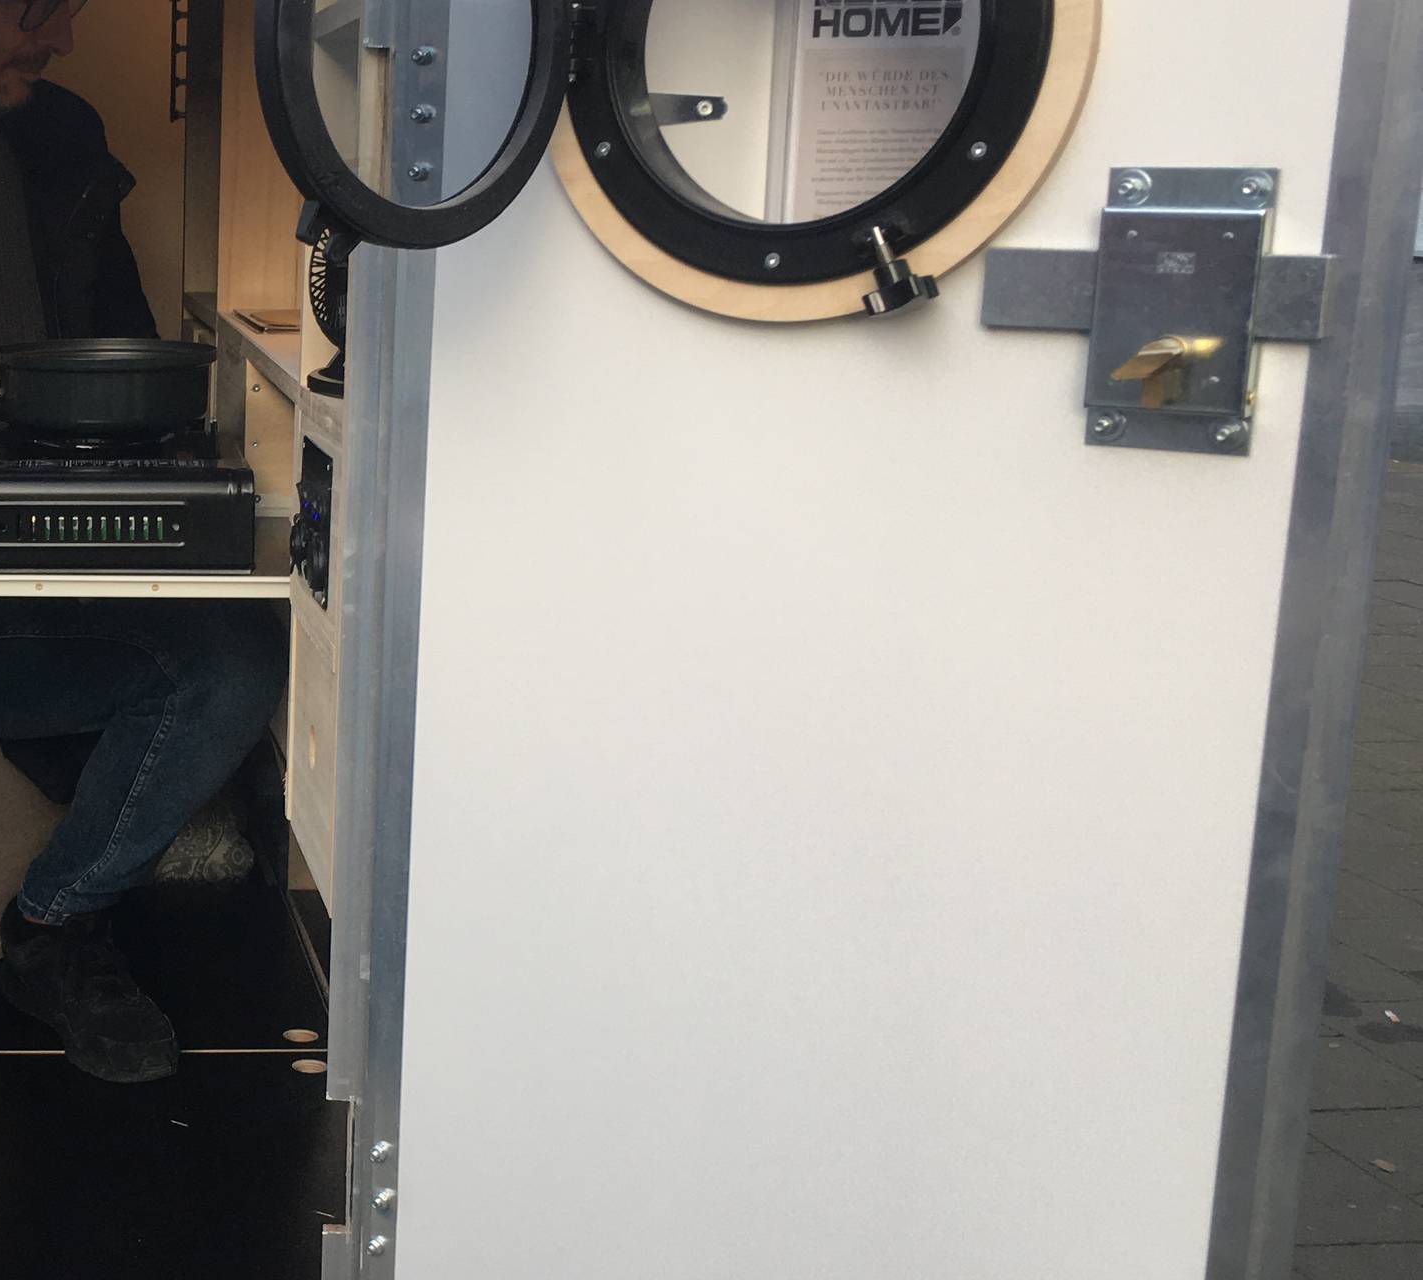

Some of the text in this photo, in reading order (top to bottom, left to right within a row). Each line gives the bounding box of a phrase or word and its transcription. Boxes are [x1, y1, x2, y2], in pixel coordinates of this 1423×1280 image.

[857, 67, 913, 81] WÜRDE
[919, 70, 952, 81] DES
[825, 84, 940, 97] MENSCHEN IST
